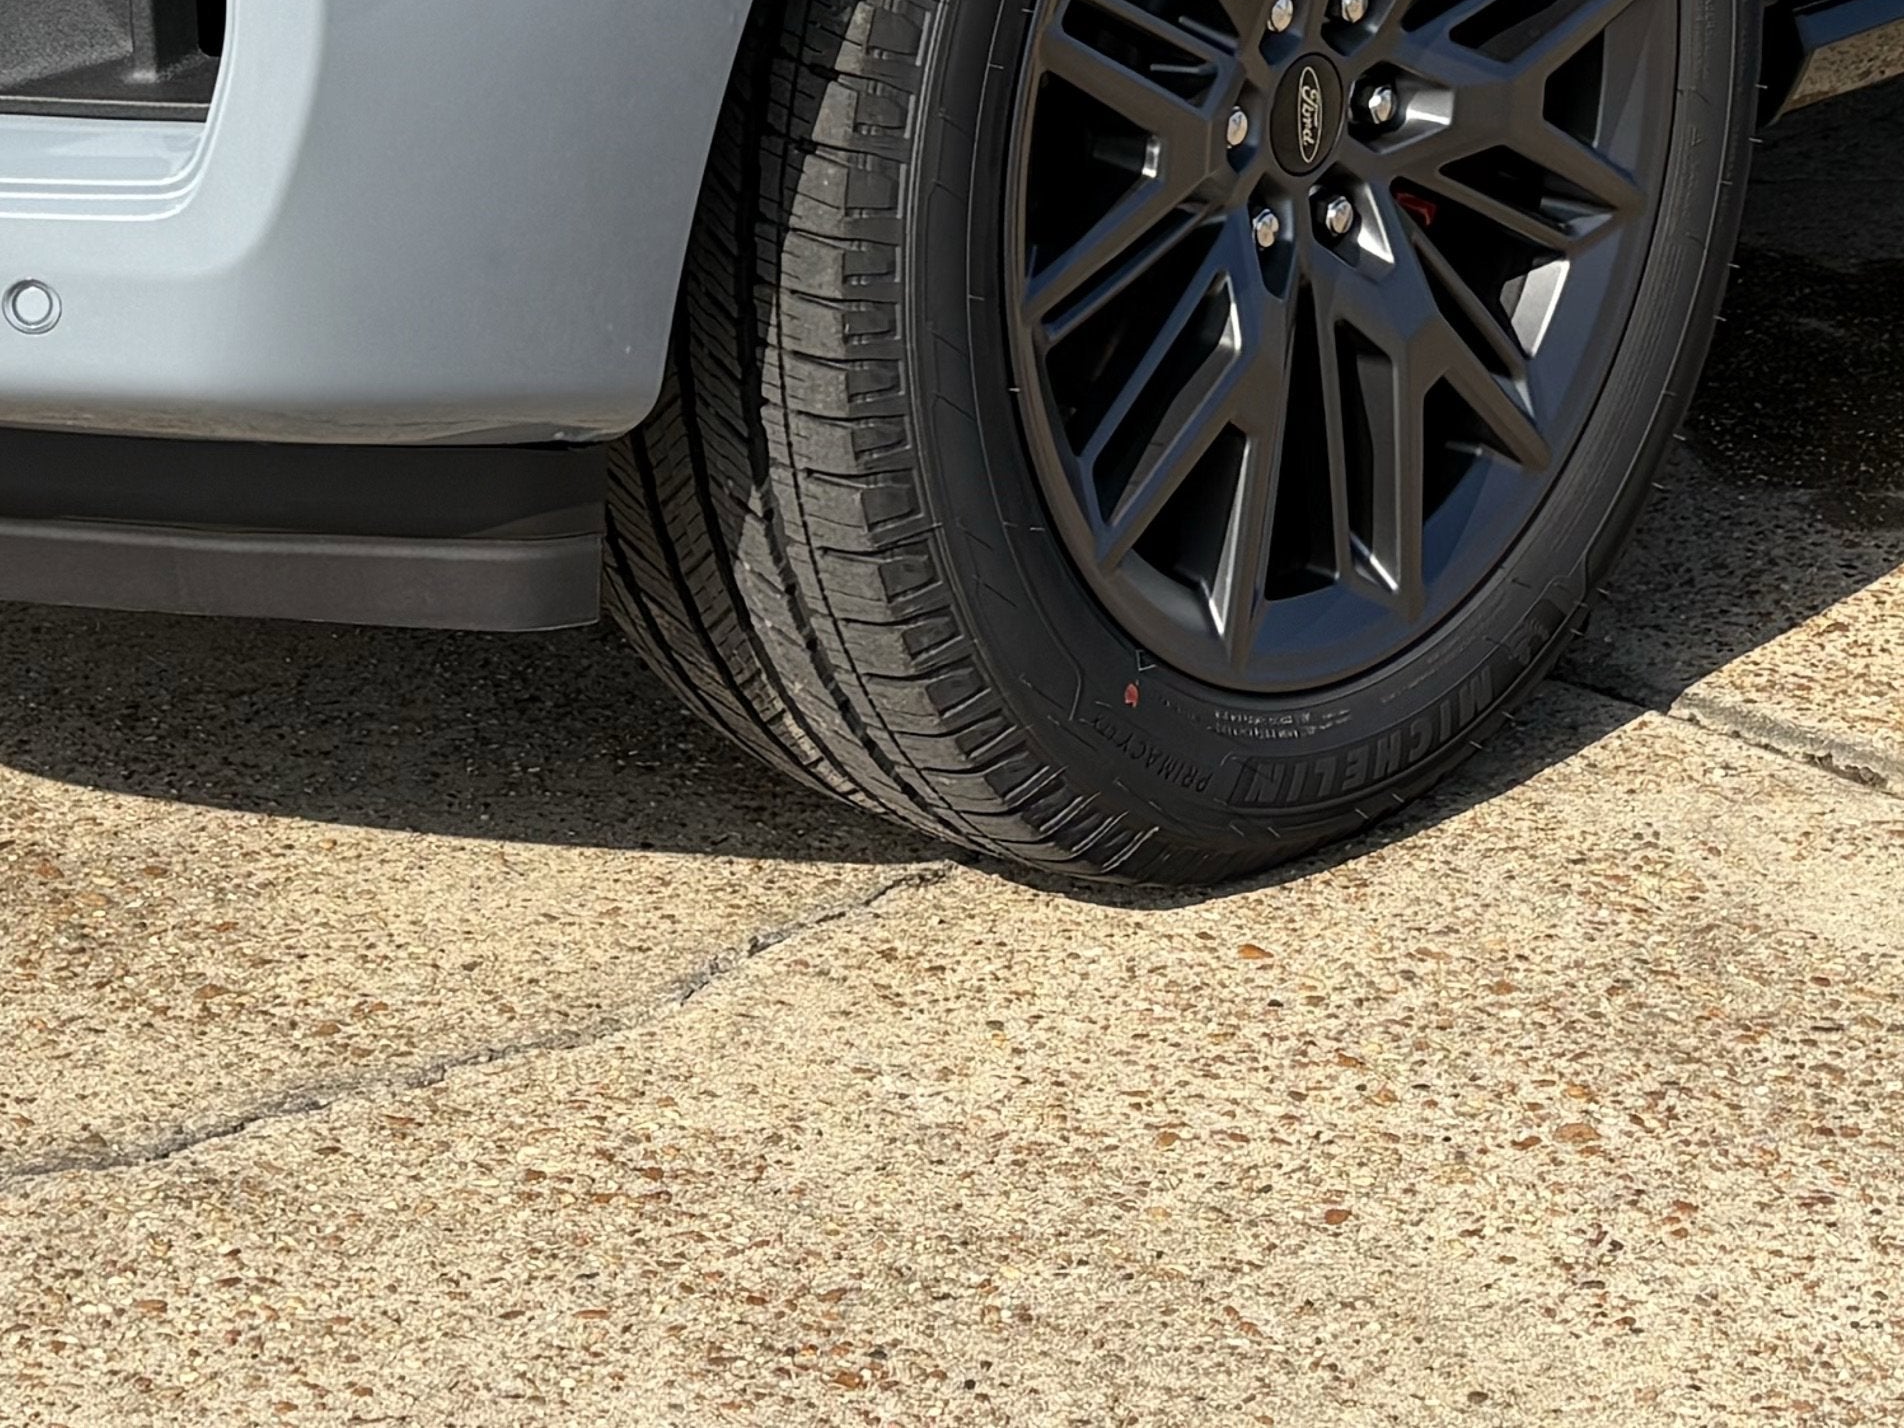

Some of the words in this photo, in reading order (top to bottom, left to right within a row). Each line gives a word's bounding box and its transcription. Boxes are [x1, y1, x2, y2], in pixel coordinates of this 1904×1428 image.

[1301, 85, 1321, 145] Ford
[1116, 731, 1214, 793] PRIMACY
[1245, 665, 1495, 803] MICHELIN
